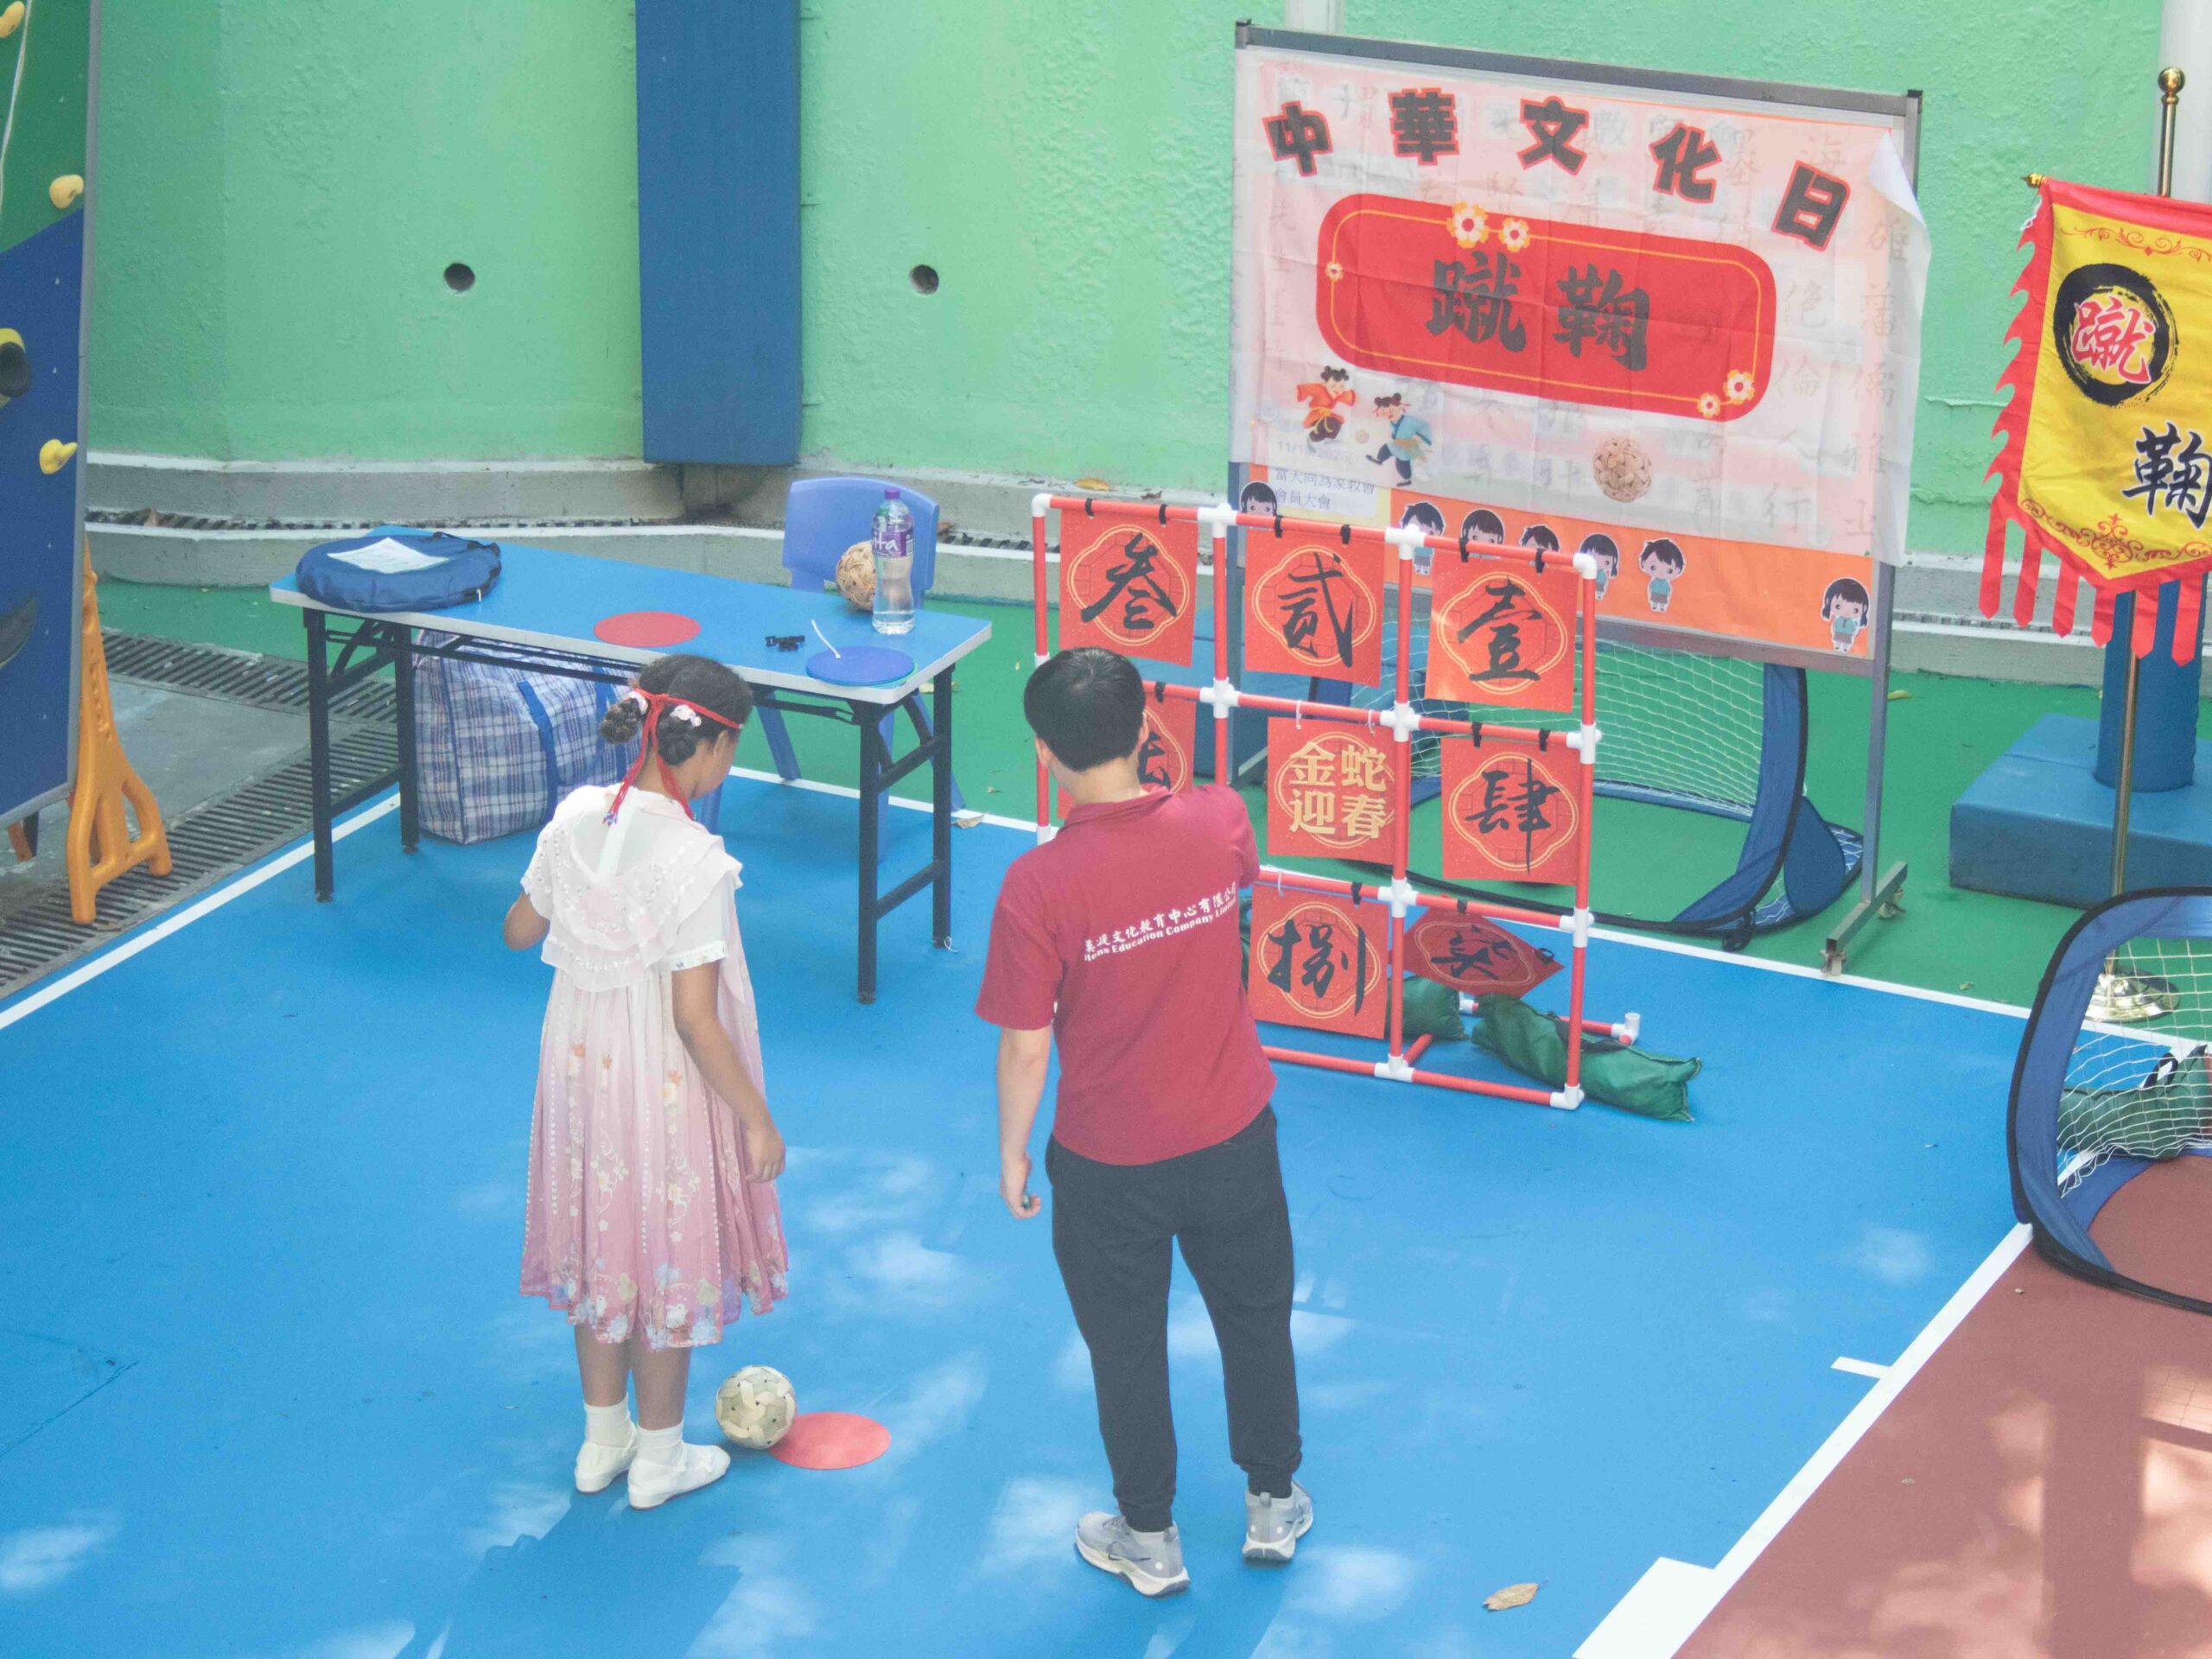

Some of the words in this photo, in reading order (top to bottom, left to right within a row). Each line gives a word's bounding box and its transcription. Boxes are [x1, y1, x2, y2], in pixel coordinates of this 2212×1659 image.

[1263, 87, 1851, 252] 中華文化日
[1425, 250, 1651, 372] 蹴鞠
[2070, 296, 2156, 384] 蹴
[2121, 421, 2212, 530] 鞠
[1457, 576, 1541, 682] 壹
[1288, 788, 1388, 840] 迎春
[1289, 741, 1388, 792] 金蛇
[1112, 930, 1164, 953] Education
[1166, 914, 1214, 936] Company
